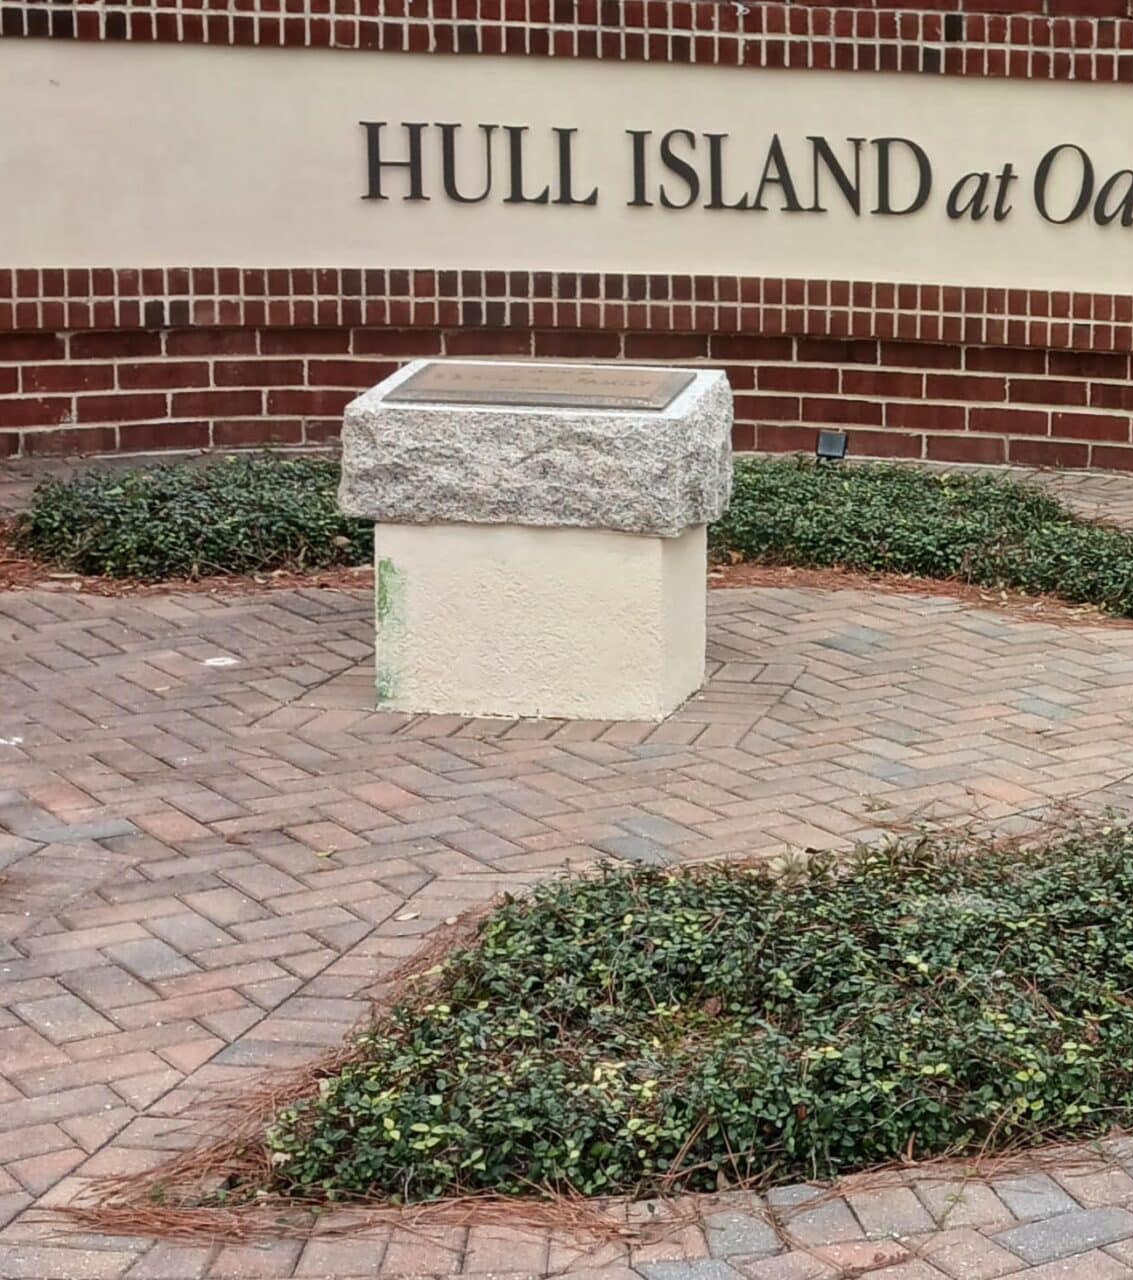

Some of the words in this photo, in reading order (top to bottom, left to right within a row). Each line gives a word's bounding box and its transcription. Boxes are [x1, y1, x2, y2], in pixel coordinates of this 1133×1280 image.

[358, 121, 598, 207] HULL
[625, 128, 932, 218] ISLAND
[945, 162, 1019, 223] at
